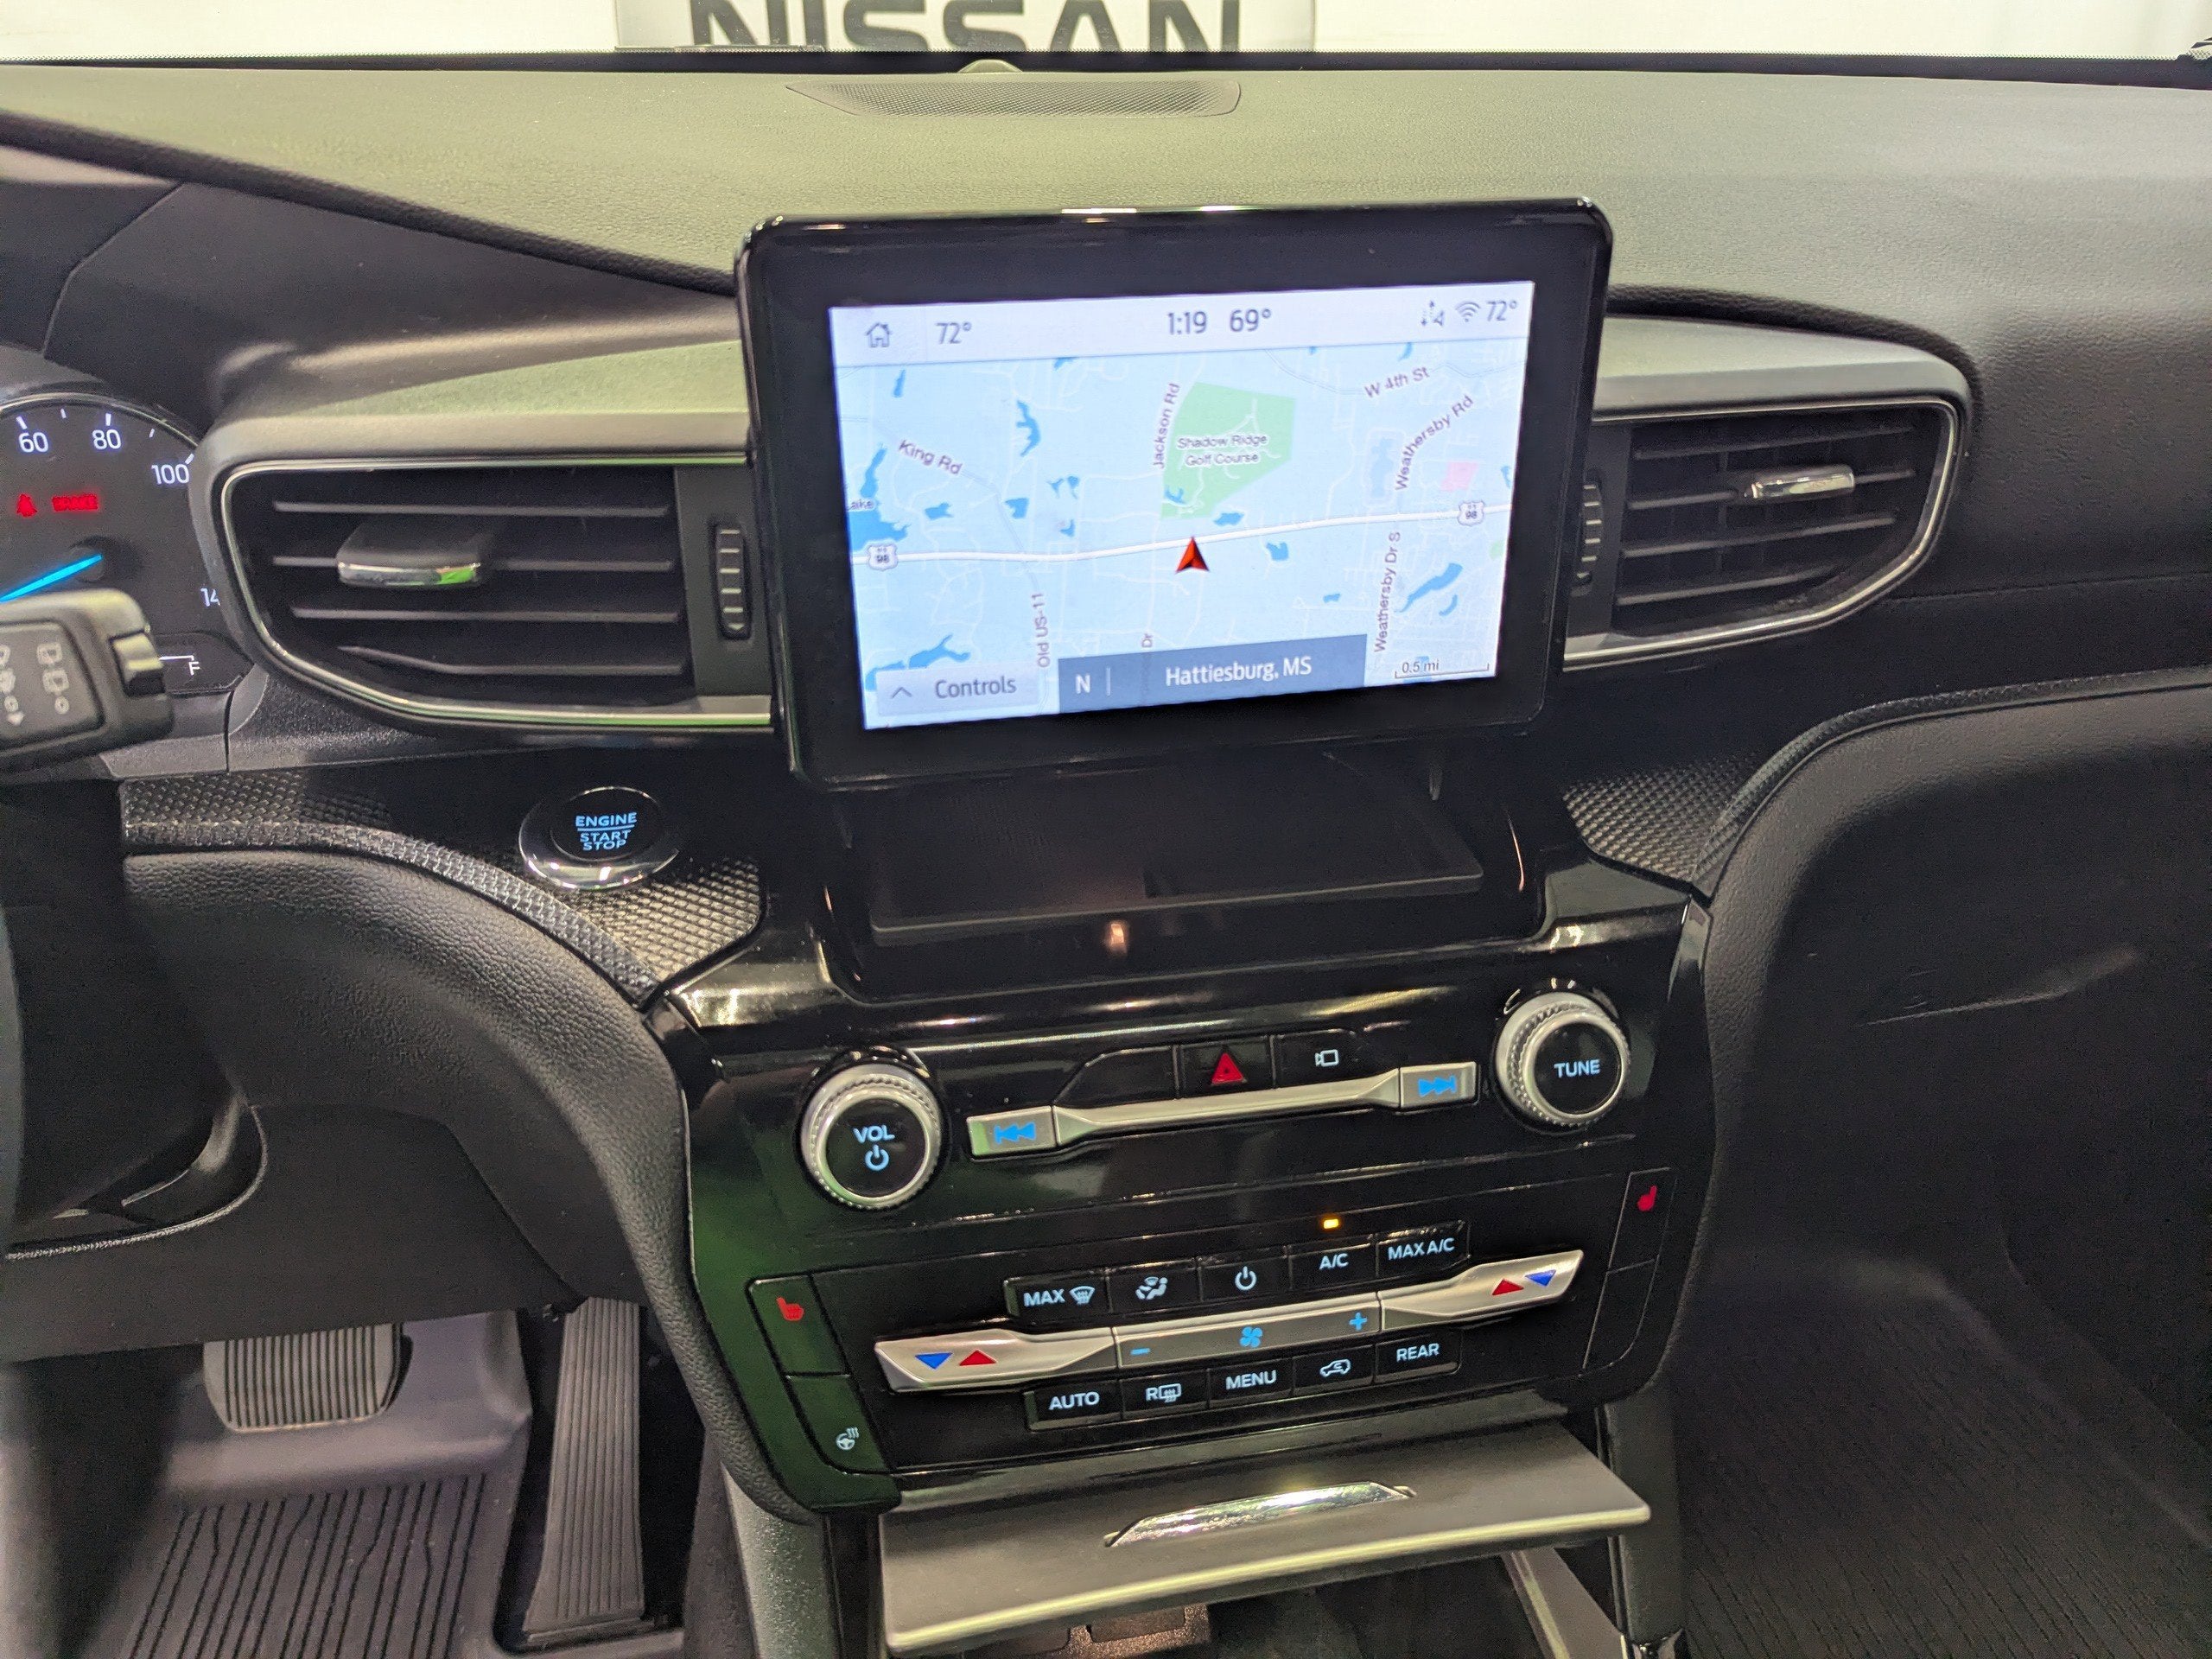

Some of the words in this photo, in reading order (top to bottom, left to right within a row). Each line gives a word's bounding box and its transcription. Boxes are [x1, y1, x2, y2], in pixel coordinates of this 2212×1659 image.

[692, 0, 1239, 52] NISSAN
[1167, 311, 1207, 335] 1:19
[1230, 308, 1271, 333] 69°
[935, 321, 972, 345] 72°
[1363, 384, 1382, 398] W
[1384, 373, 1409, 392] 4th
[1412, 366, 1429, 383] St
[1152, 410, 1173, 470] Jackson
[1168, 383, 1180, 407] Rd
[18, 432, 49, 454] 60
[92, 429, 122, 450] 80
[1177, 435, 1227, 449] Shadow
[1230, 433, 1268, 448] Ridge
[1395, 415, 1451, 491] Weathersby
[1452, 396, 1474, 417] Rd
[899, 438, 936, 467] King
[938, 454, 963, 476] Rd
[1185, 454, 1211, 468] Golf
[1214, 452, 1259, 466] Course
[150, 463, 190, 485] 100
[1389, 531, 1402, 543] S
[1385, 547, 1399, 568] Dr
[1031, 593, 1049, 639] US-11
[1374, 571, 1395, 652] Weathersby
[1141, 632, 1154, 648] Dr
[1037, 643, 1051, 668] Old
[188, 660, 200, 676] F
[1165, 661, 1279, 687] Hattiesburg,
[1282, 657, 1313, 677] MS
[1402, 661, 1421, 674] 0.5
[1423, 660, 1440, 672] mi
[935, 676, 1017, 699] Controls
[1075, 674, 1091, 695] N
[575, 812, 638, 827] ENGINE
[580, 830, 631, 842] START
[582, 839, 626, 851] STOP
[1554, 1059, 1601, 1080] TUNE
[853, 1125, 895, 1143] VOL
[1388, 1242, 1424, 1260] MAX
[1427, 1237, 1455, 1254] A/C
[1319, 1253, 1349, 1270] A/C
[1023, 1288, 1066, 1307] MAX
[1395, 1343, 1440, 1363] REAR
[1225, 1370, 1277, 1389] MENU
[1048, 1391, 1100, 1410] AUTO
[1145, 1387, 1159, 1402] R
